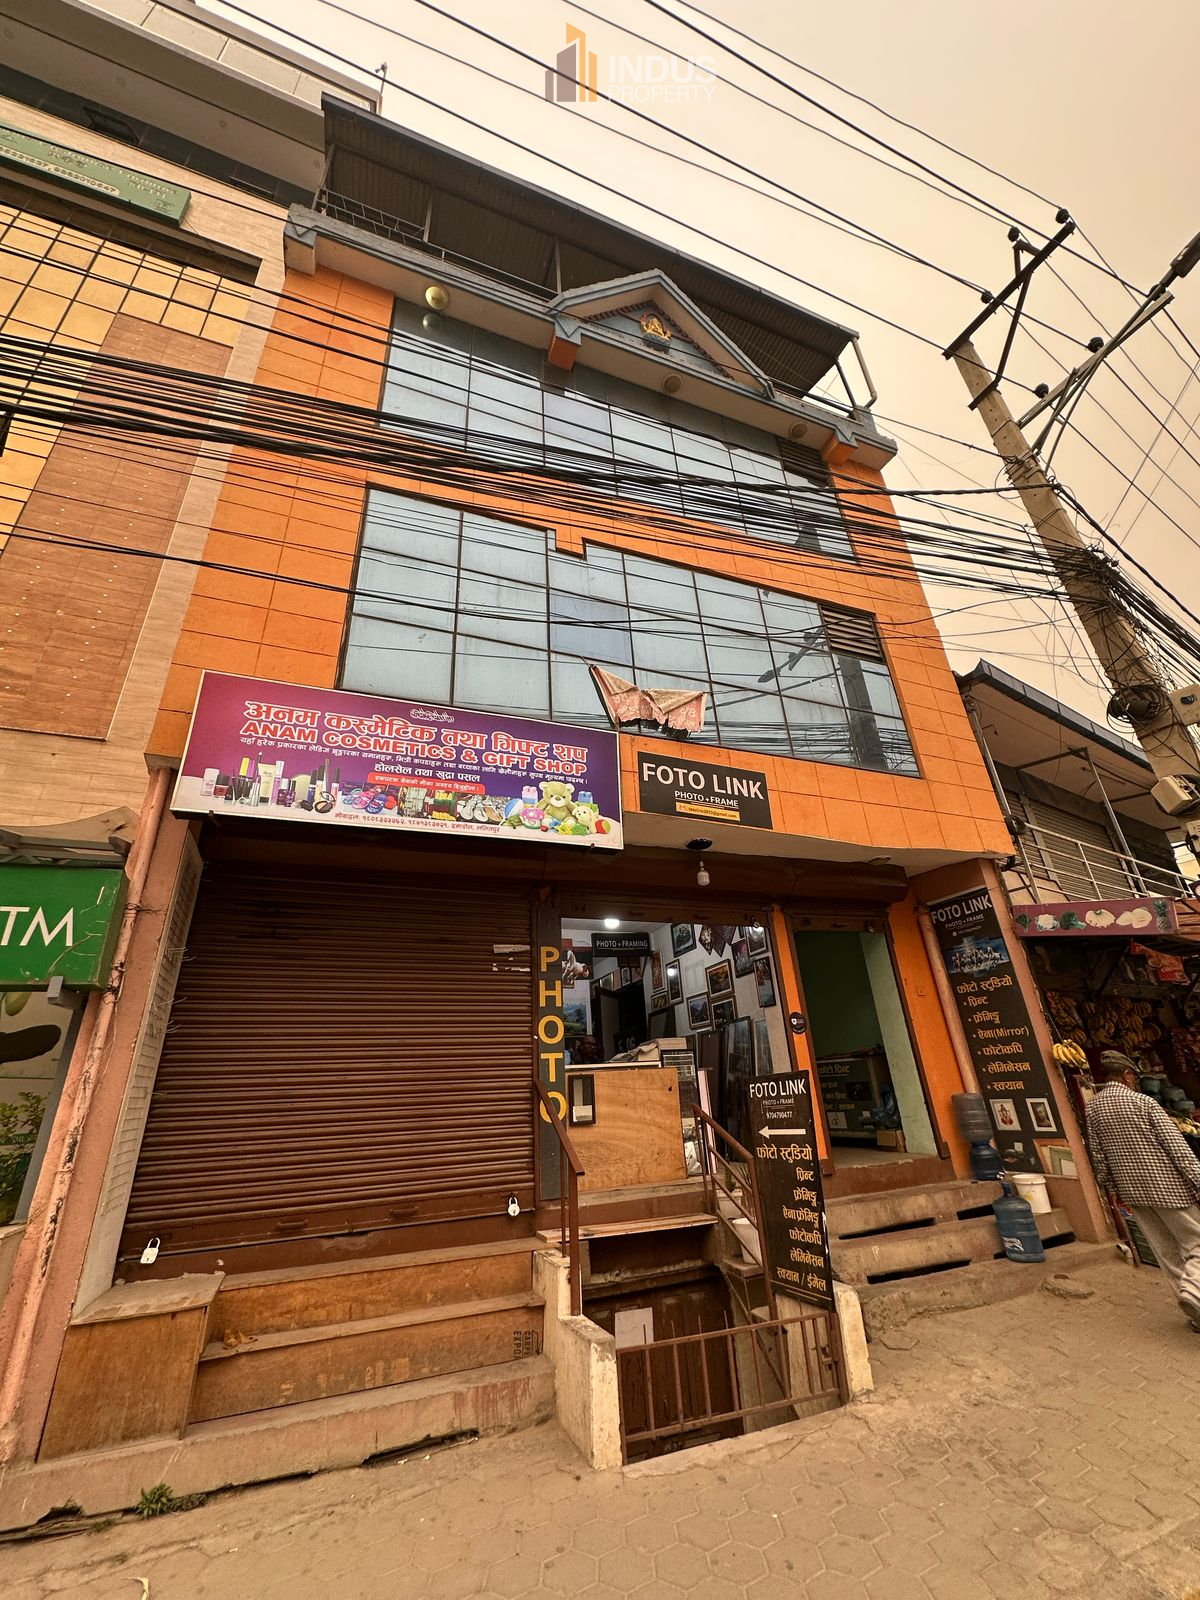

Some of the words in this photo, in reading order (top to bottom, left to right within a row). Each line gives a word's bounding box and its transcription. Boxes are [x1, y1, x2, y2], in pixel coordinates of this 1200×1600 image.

[244, 700, 321, 727] अनम
[324, 712, 437, 741] कस्मेटिक
[441, 728, 487, 749] तथा
[492, 731, 550, 757] गिफ्ट
[553, 743, 588, 763] शप
[239, 720, 318, 743] ANAM
[322, 731, 456, 760] COSMETICS
[461, 748, 478, 764] &
[482, 751, 530, 769] GIFT
[534, 758, 588, 776] SHOP
[374, 762, 412, 775] होलसेल
[415, 768, 433, 777] तथा
[436, 770, 455, 780] खुद्रा
[457, 774, 480, 782] पसल
[642, 762, 705, 790] FOTO
[712, 774, 764, 800] LINK
[674, 790, 704, 802] PHOTO
[710, 796, 739, 807] FRAME
[930, 904, 961, 924] FOTO
[962, 894, 993, 915] LINK
[596, 940, 617, 948] PHOTO
[622, 940, 648, 948] FRAMING
[956, 980, 978, 994] फोटो
[980, 974, 1013, 992] स्टुडियो
[968, 995, 989, 1007] प्रिन्ट
[537, 946, 567, 1123] PHOTO
[749, 1081, 777, 1098] FOTO
[779, 1078, 807, 1096] LINK
[756, 1144, 777, 1159] फोटो
[780, 1143, 812, 1163] स्टुडियो
[796, 1166, 815, 1181] प्रिन्ट
